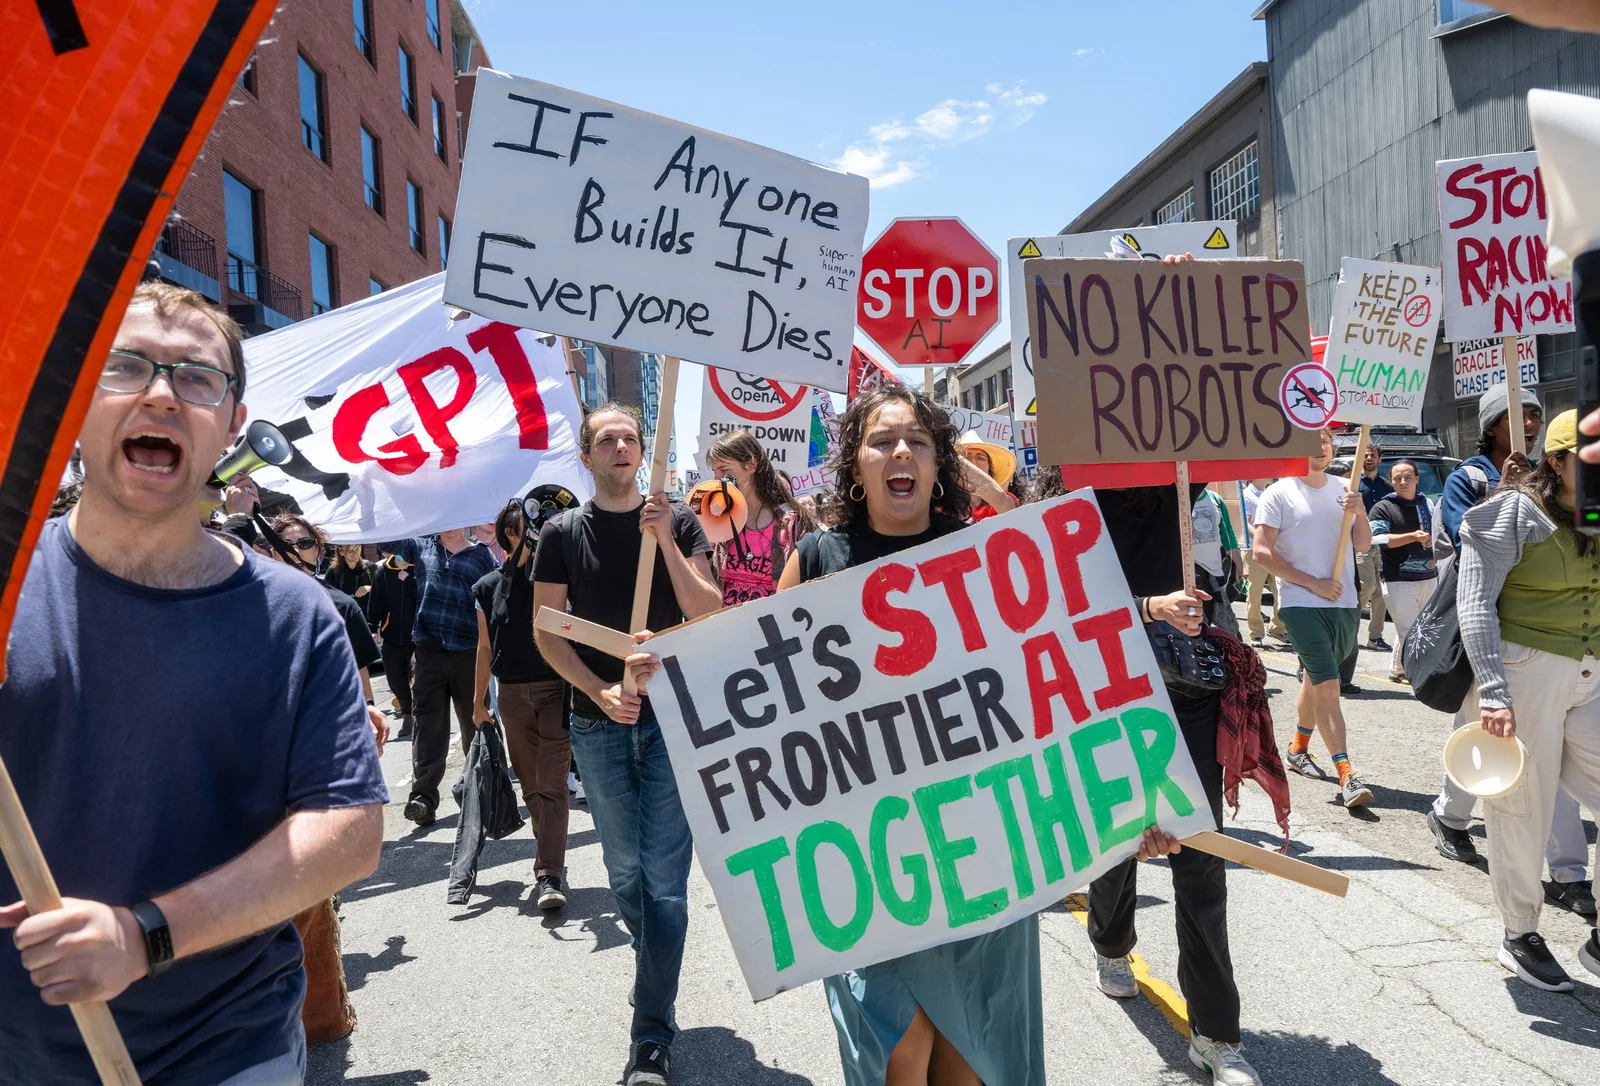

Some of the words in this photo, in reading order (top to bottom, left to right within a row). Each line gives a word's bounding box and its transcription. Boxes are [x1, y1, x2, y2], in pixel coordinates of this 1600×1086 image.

[491, 92, 615, 167] IF
[653, 135, 840, 232] Anyone
[574, 176, 695, 256] Builds
[714, 220, 808, 291] It,
[821, 258, 856, 278] human
[825, 275, 849, 291] AI
[1457, 234, 1556, 307] RACIN
[473, 230, 715, 340] Everyone
[741, 290, 845, 367] Dies.
[863, 267, 994, 319] STOP
[1358, 272, 1417, 304] KEEP
[1035, 272, 1120, 359] NO
[1134, 272, 1306, 360] KILLER
[1358, 301, 1403, 327] THE
[1494, 281, 1573, 334] NOW
[902, 318, 952, 350] AI
[1344, 322, 1428, 358] FUTURE
[1457, 338, 1491, 354] PARK
[1337, 354, 1426, 393] HUMAN
[1454, 348, 1499, 376] ORACLE
[1502, 340, 1535, 366] RK
[332, 320, 549, 476] GPT
[731, 387, 786, 404] OpenA
[1455, 373, 1489, 397] CHASE
[1492, 363, 1537, 386] CEER
[1089, 362, 1293, 457] ROBOTS
[1339, 390, 1368, 406] STOP
[1365, 392, 1381, 406] AI
[1382, 393, 1415, 408] NOW!
[755, 426, 806, 443] DOWN
[986, 419, 1011, 441] THE
[661, 606, 862, 750] Let's
[861, 498, 1103, 677] STOP
[698, 667, 1024, 834] FRONTIER
[1021, 606, 1154, 740] AI
[724, 706, 1196, 973] TOGETHER
